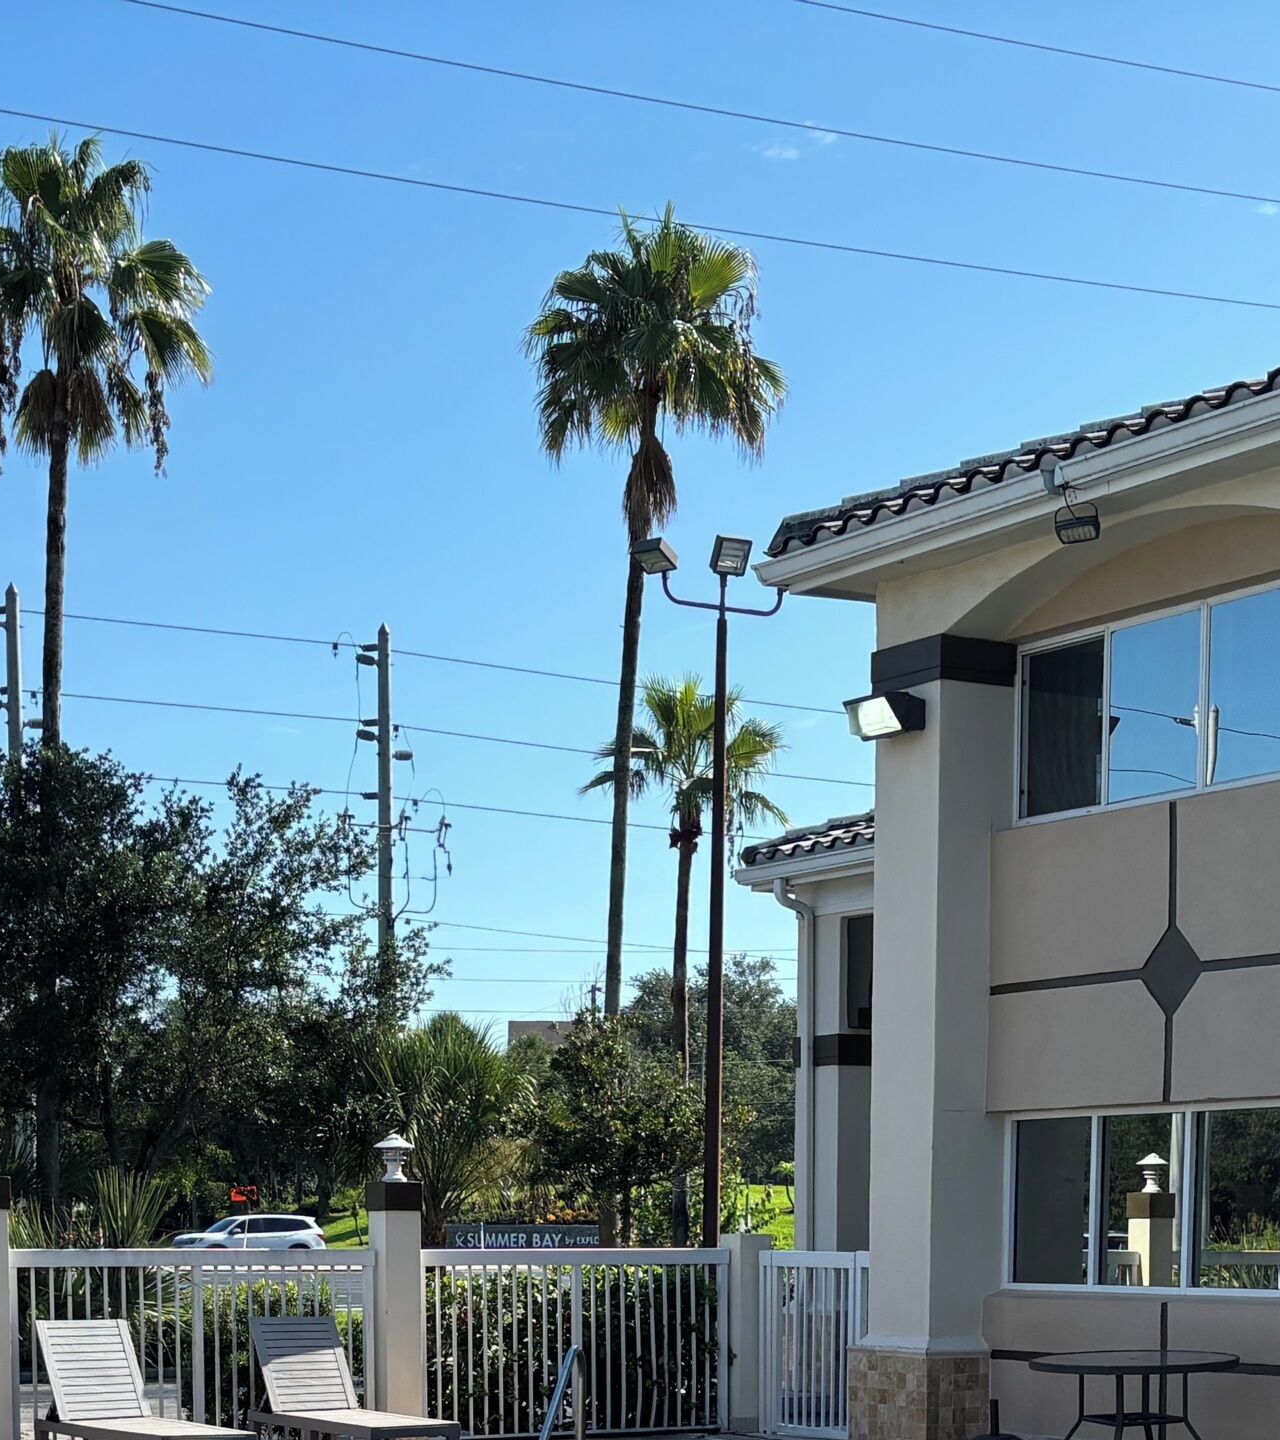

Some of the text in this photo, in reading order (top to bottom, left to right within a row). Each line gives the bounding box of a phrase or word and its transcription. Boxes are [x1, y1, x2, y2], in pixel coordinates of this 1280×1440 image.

[468, 1233, 526, 1247] SUMMER
[532, 1233, 562, 1247] BAY
[565, 1236, 574, 1246] by
